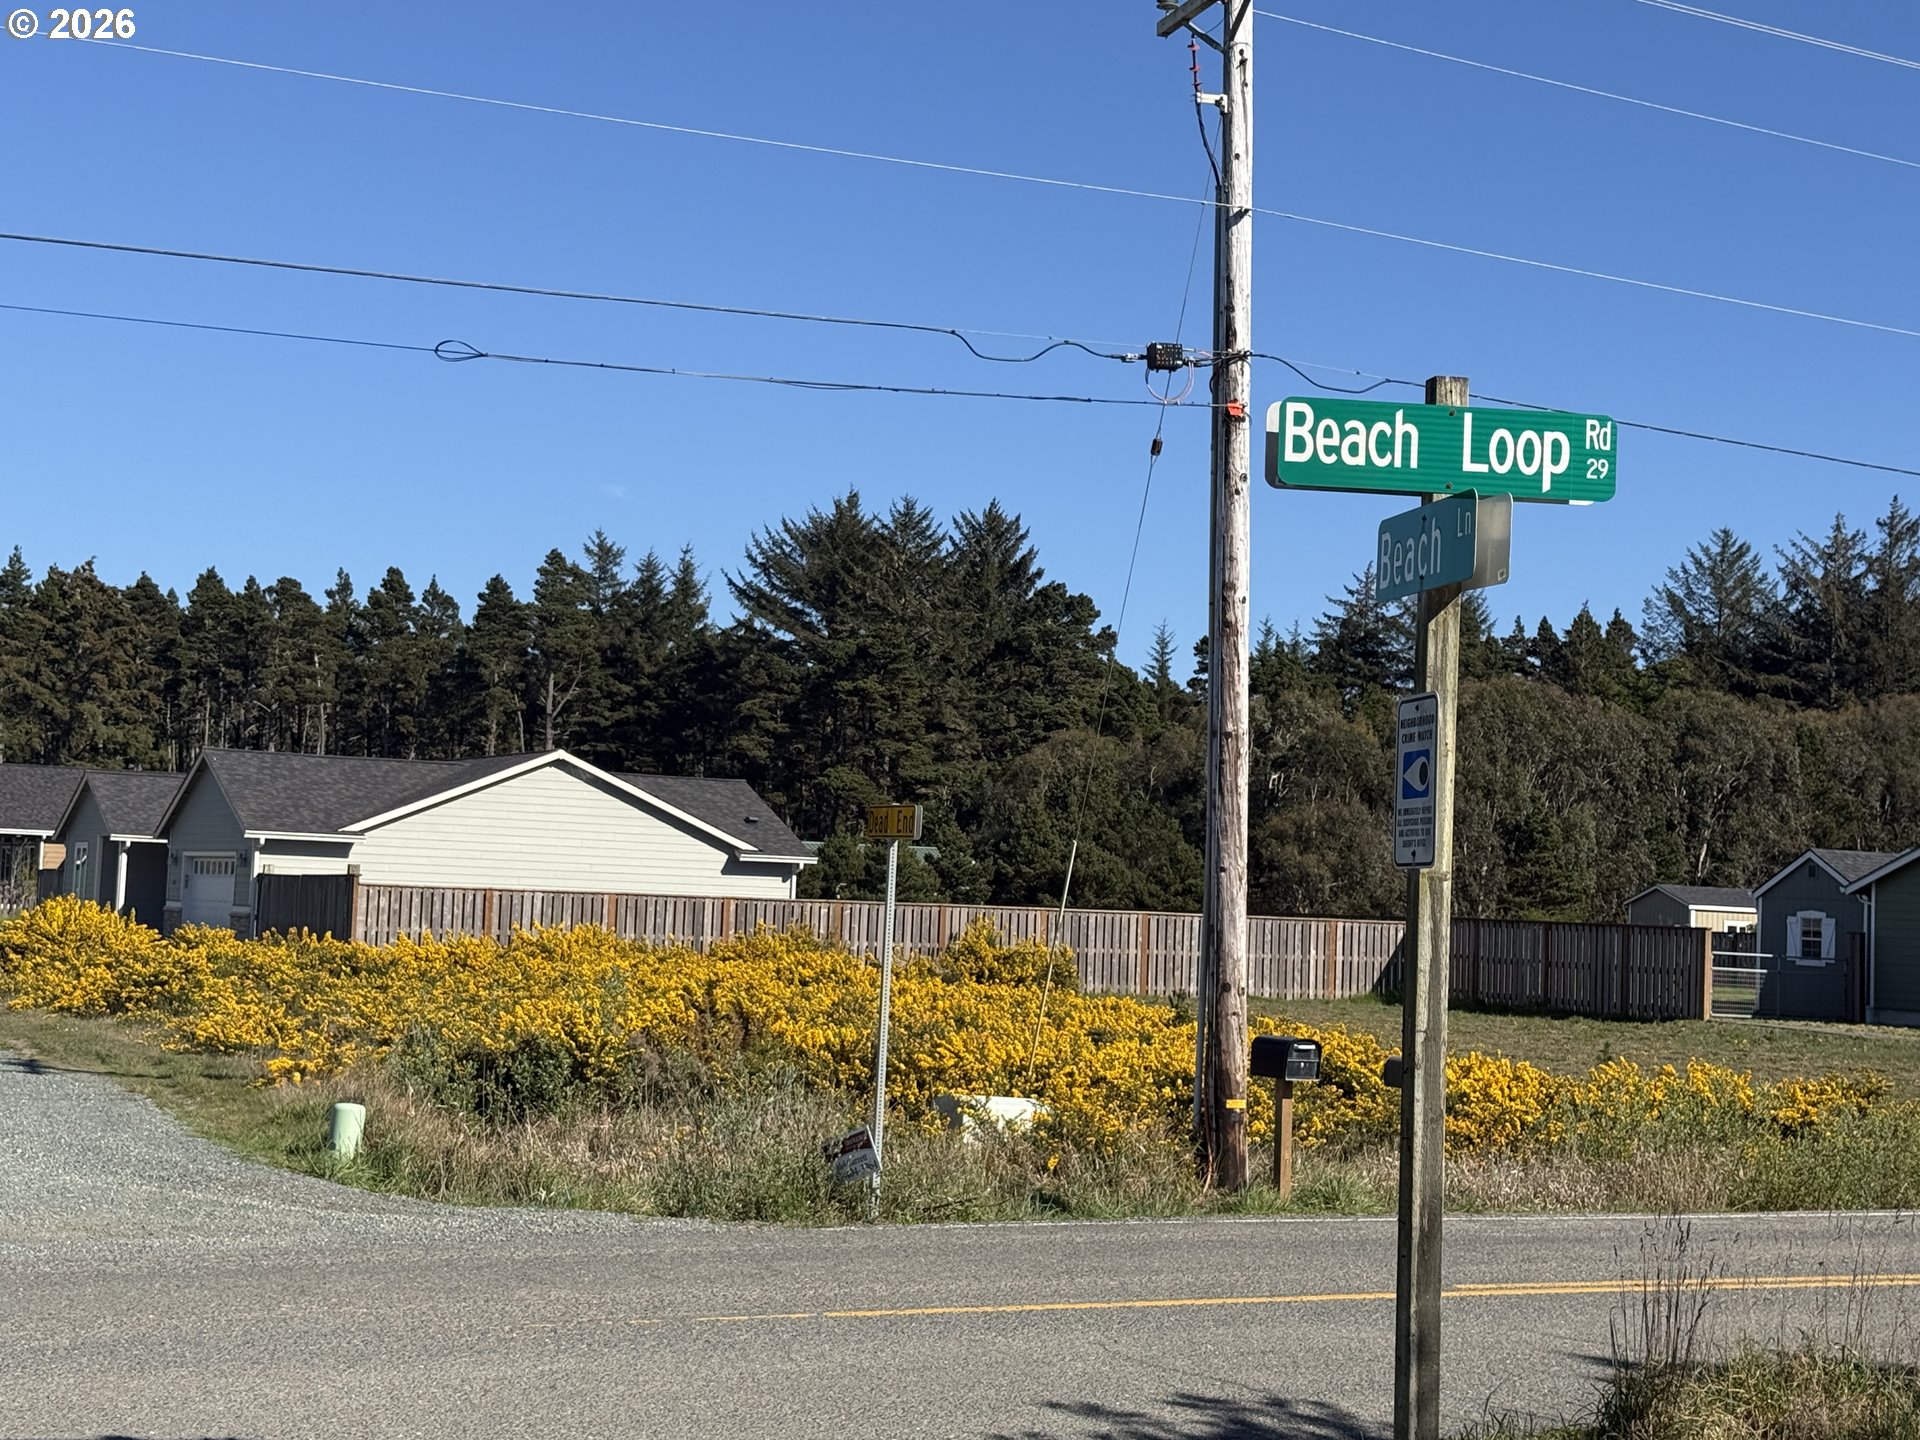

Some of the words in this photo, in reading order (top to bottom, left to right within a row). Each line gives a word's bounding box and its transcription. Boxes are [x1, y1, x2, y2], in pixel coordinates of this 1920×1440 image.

[1284, 401, 1419, 469] Beach
[1462, 412, 1570, 493] Loop
[1585, 418, 1611, 451] Rd
[1586, 458, 1609, 480] 29
[1379, 517, 1441, 590] Beach
[1457, 507, 1472, 538] Ln
